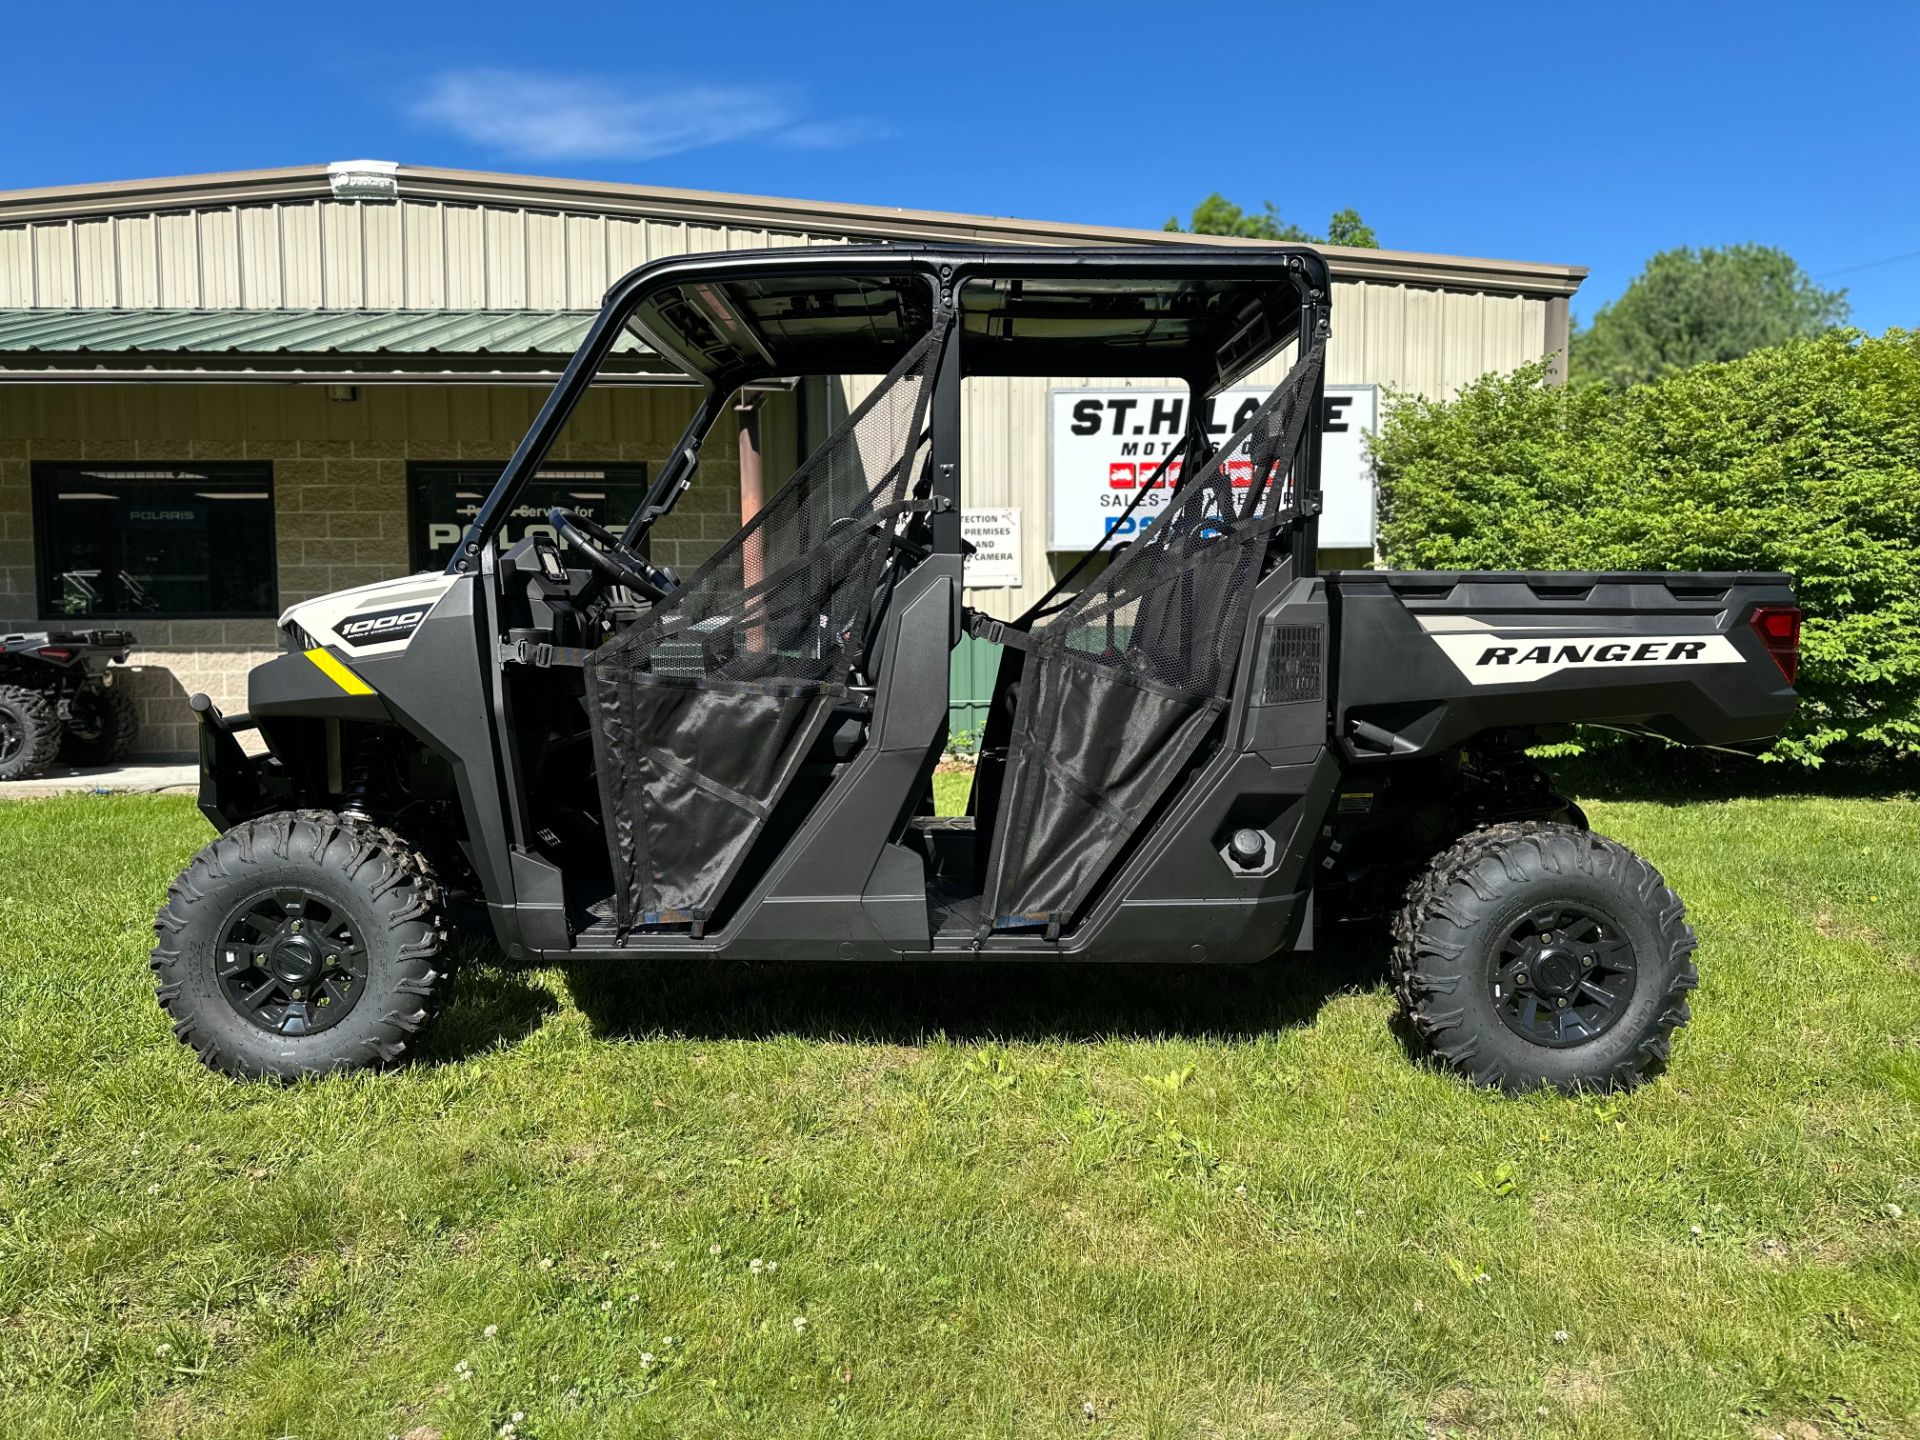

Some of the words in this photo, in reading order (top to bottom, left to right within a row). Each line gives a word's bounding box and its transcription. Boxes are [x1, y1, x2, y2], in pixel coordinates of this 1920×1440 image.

[129, 511, 195, 520] POLARIS
[573, 505, 595, 518] for
[964, 528, 1011, 536] PREMISES
[975, 540, 995, 548] AND
[974, 552, 1013, 561] CAMERA
[341, 611, 423, 636] 1000
[1475, 641, 1707, 666] RANGER
